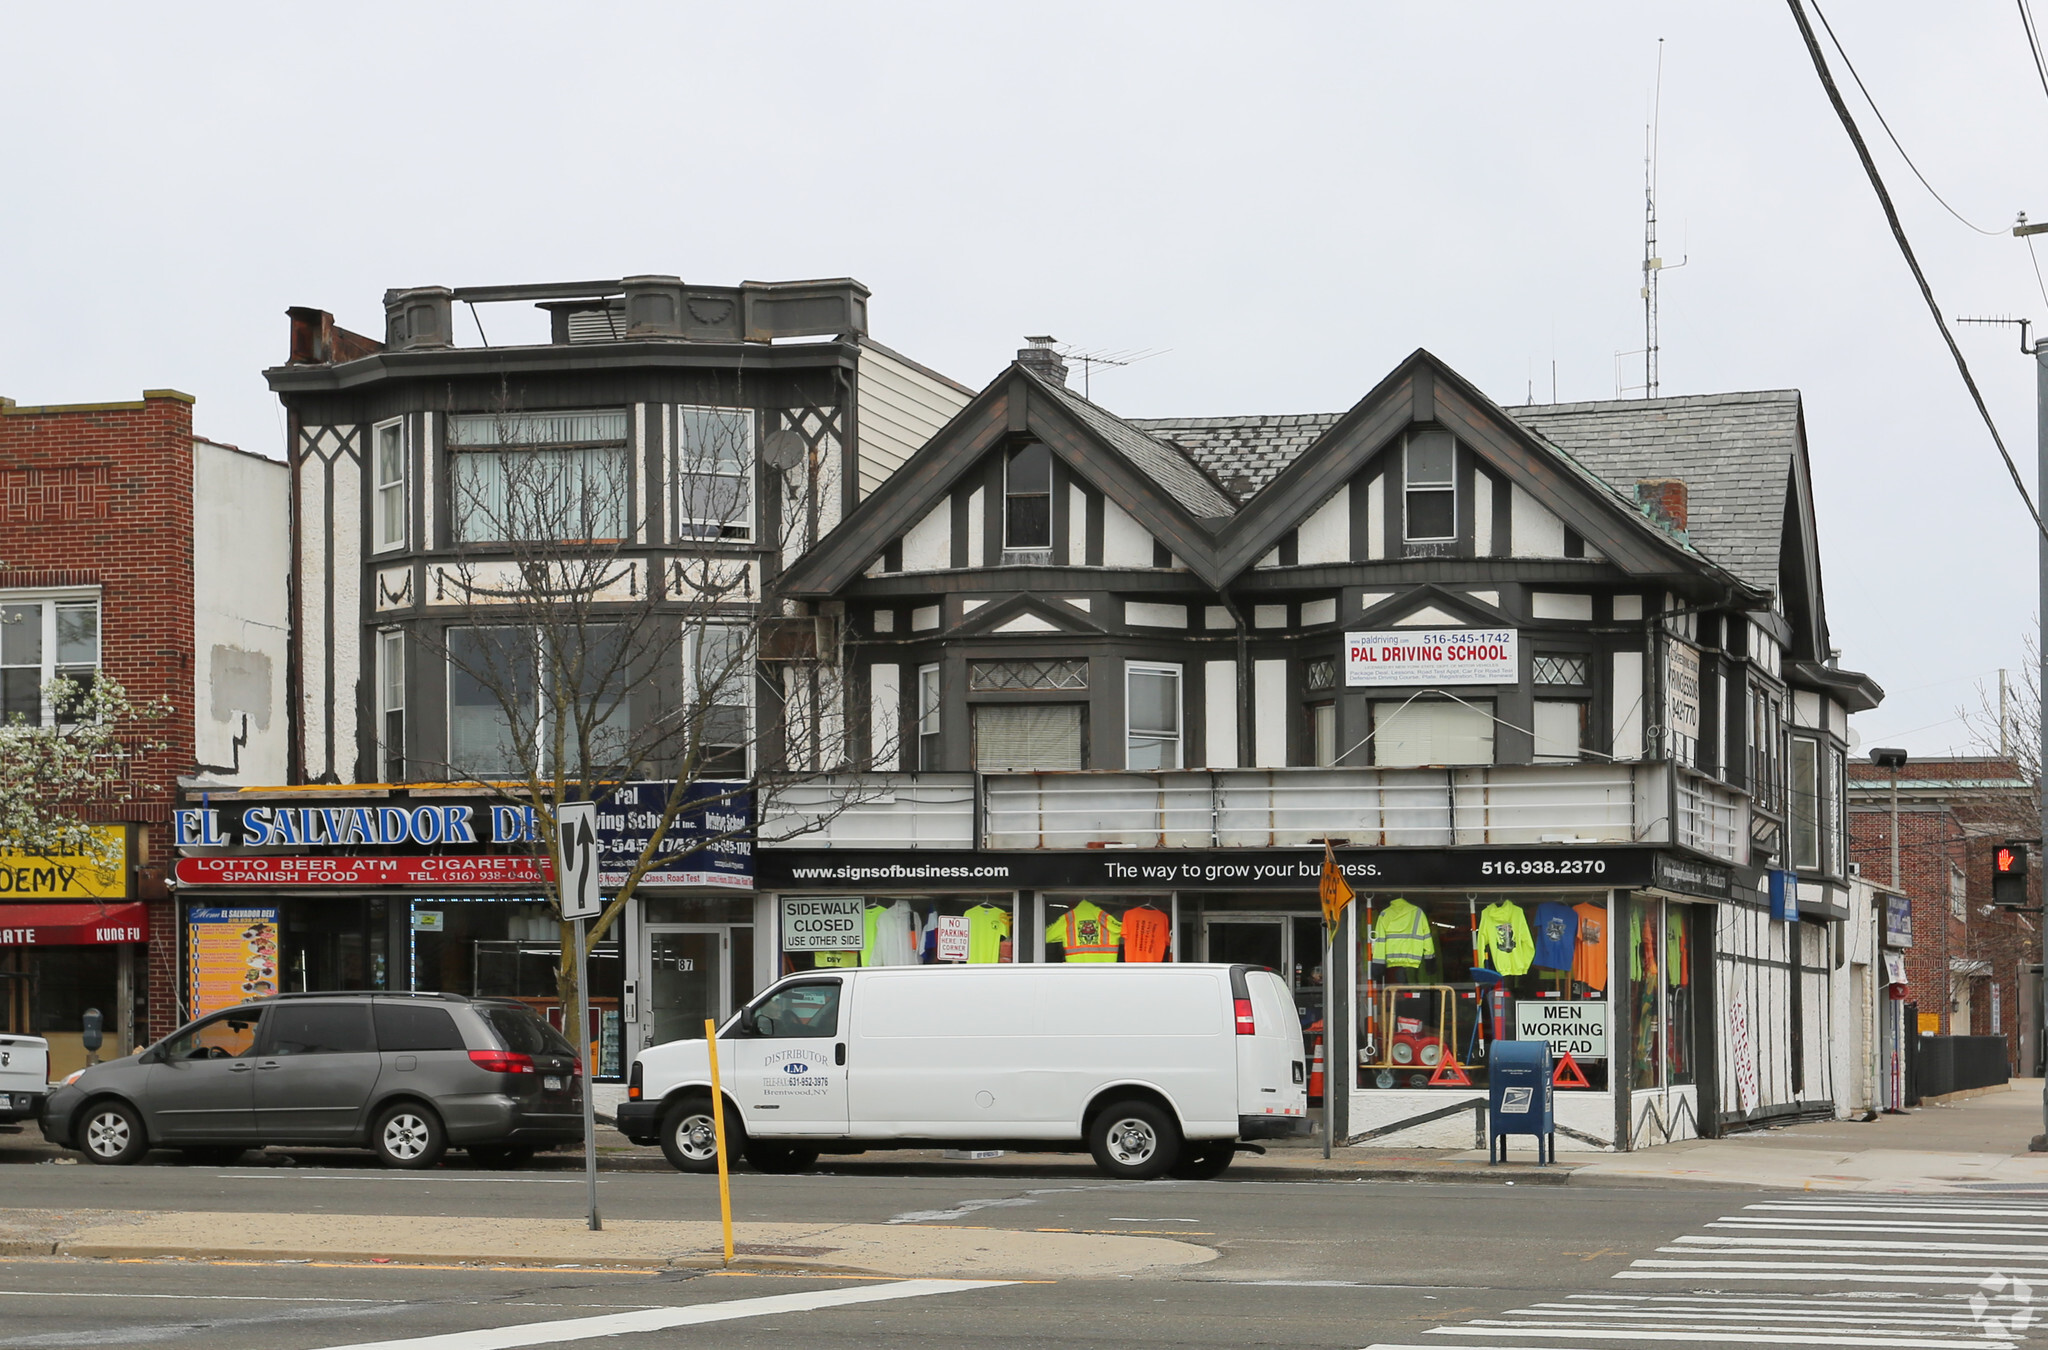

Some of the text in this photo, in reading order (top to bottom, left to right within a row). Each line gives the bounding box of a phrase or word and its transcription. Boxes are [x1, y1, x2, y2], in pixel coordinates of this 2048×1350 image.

[1424, 633, 1510, 644] 516-545-1742
[1351, 647, 1377, 662] PAL
[1382, 646, 1442, 662] DRIVING
[1448, 645, 1508, 661] SCHOOL
[614, 787, 638, 805] Pal
[173, 808, 231, 847] EL
[242, 806, 479, 847] SALVADOR
[198, 860, 268, 870] LOTTO
[280, 860, 336, 870] BEER
[352, 860, 398, 870] ATM
[792, 860, 1606, 881] www.signsofbusiness.com The way to grow your buness. 516.938.2370
[222, 871, 299, 881] SPANISH
[307, 871, 358, 881] FOOD
[408, 872, 438, 881] TEL.
[442, 871, 475, 882] (516)
[667, 874, 684, 882] Road
[686, 874, 700, 882] Test
[787, 902, 861, 916] SIDEWALK
[794, 919, 854, 932] CLOSED
[96, 928, 124, 941] KUNG
[128, 928, 140, 940] FU
[941, 929, 968, 938] PARKING
[788, 935, 860, 946] USE OTHER SIDE
[680, 960, 692, 970] 87
[1544, 1006, 1581, 1019] MEN
[1522, 1023, 1603, 1036] WORKING
[1550, 1040, 1592, 1053] HEAD
[764, 1049, 829, 1067] DISTRIBUTOR
